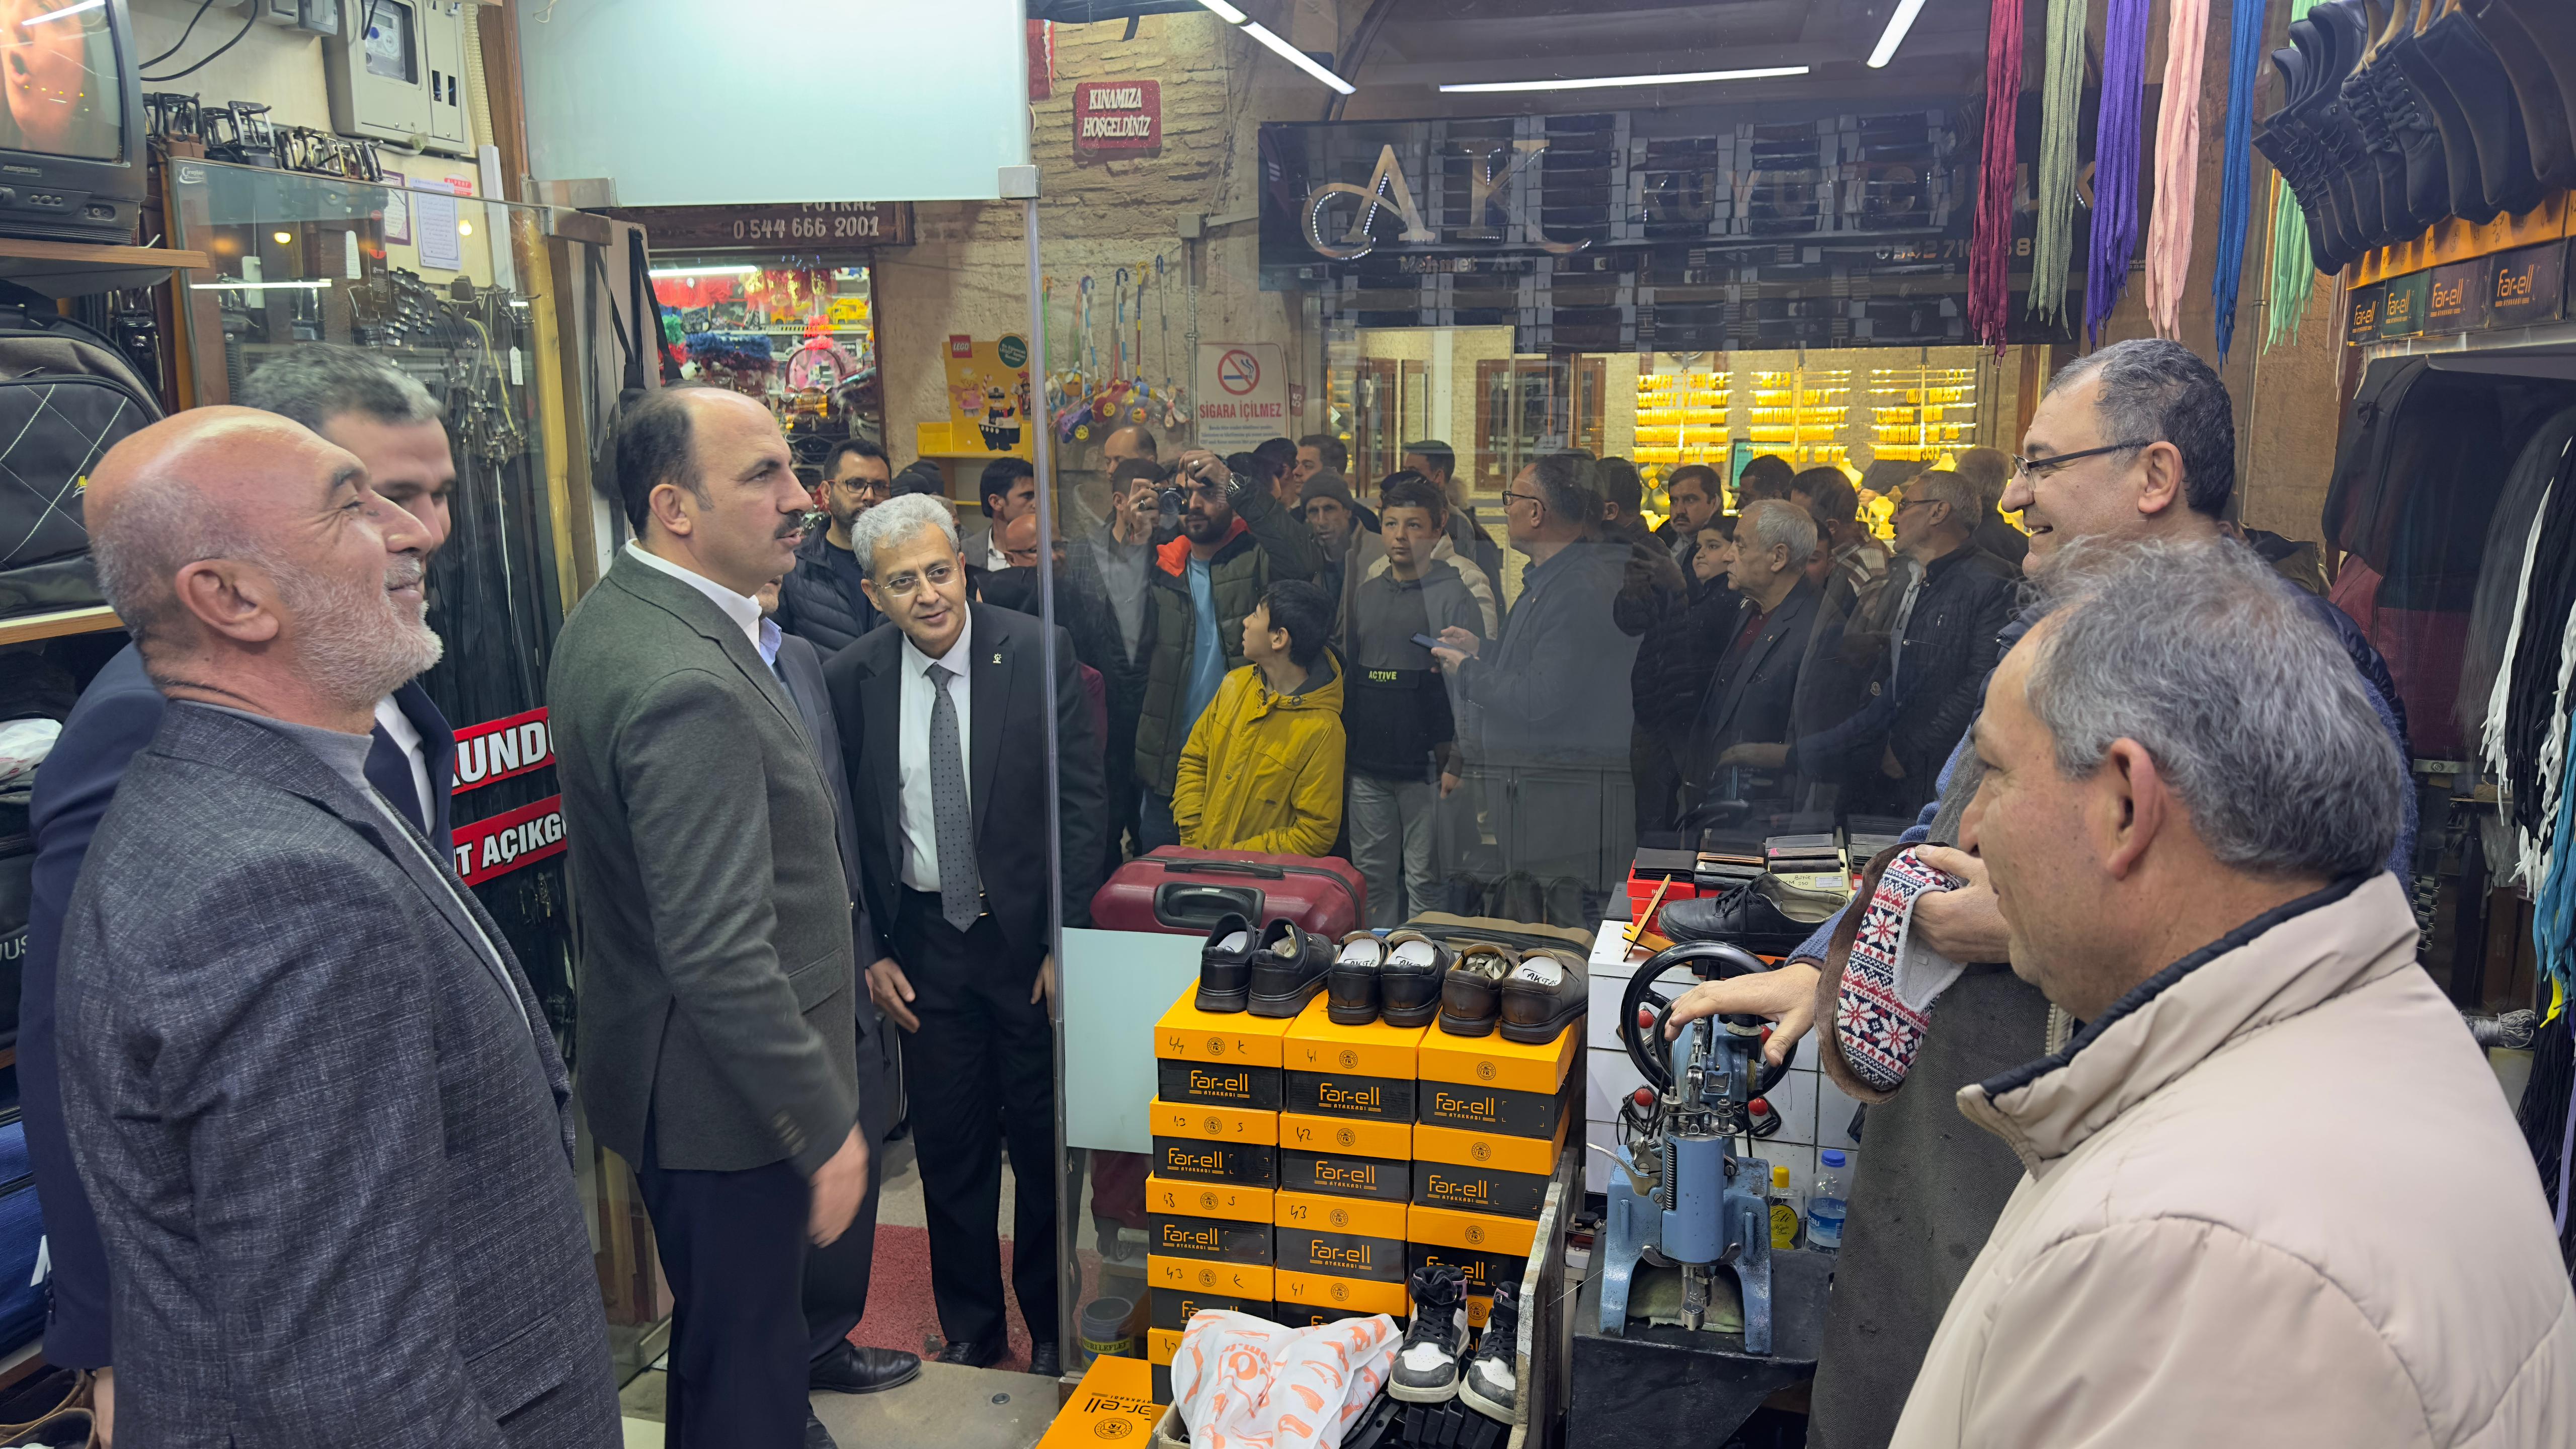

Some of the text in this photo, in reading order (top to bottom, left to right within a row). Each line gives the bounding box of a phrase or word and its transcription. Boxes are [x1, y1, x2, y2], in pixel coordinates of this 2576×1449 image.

[1089, 88, 1142, 110] KINAMIZA
[1082, 115, 1151, 138] HOŞGELDİNİZ
[750, 219, 785, 239] 544
[792, 217, 826, 237] 666
[834, 216, 879, 237] 2001
[1398, 256, 1478, 274] Mehmet
[953, 342, 969, 351] LEGO
[1199, 400, 1282, 422] SİGARA İÇİLMEZ
[1369, 671, 1397, 680] ACTIVE
[452, 718, 554, 787] UND
[1291, 1205, 1307, 1220] 43
[1166, 1266, 1183, 1280] 43
[1084, 1398, 1151, 1420] ar-ell
